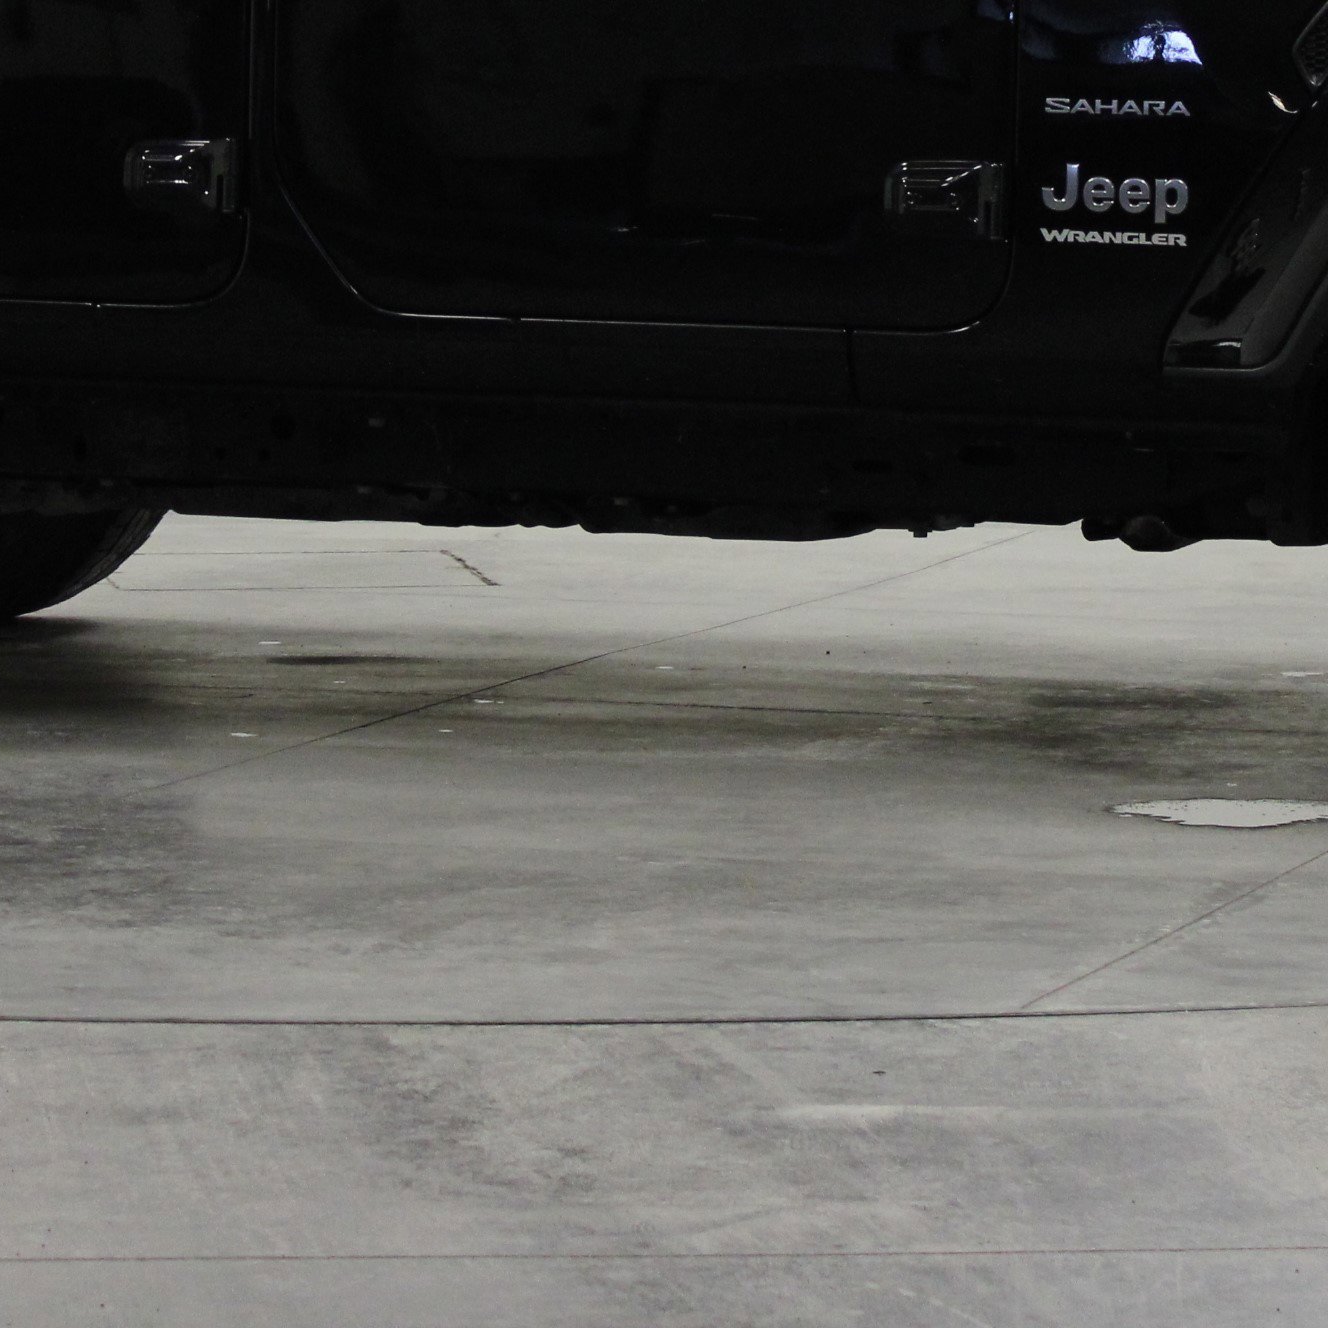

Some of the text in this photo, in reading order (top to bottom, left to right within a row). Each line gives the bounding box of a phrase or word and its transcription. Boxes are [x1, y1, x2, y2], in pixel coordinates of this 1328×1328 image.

[1044, 97, 1191, 117] SAHARA
[1041, 163, 1190, 224] Jeep
[1039, 227, 1188, 247] WRANGLER
